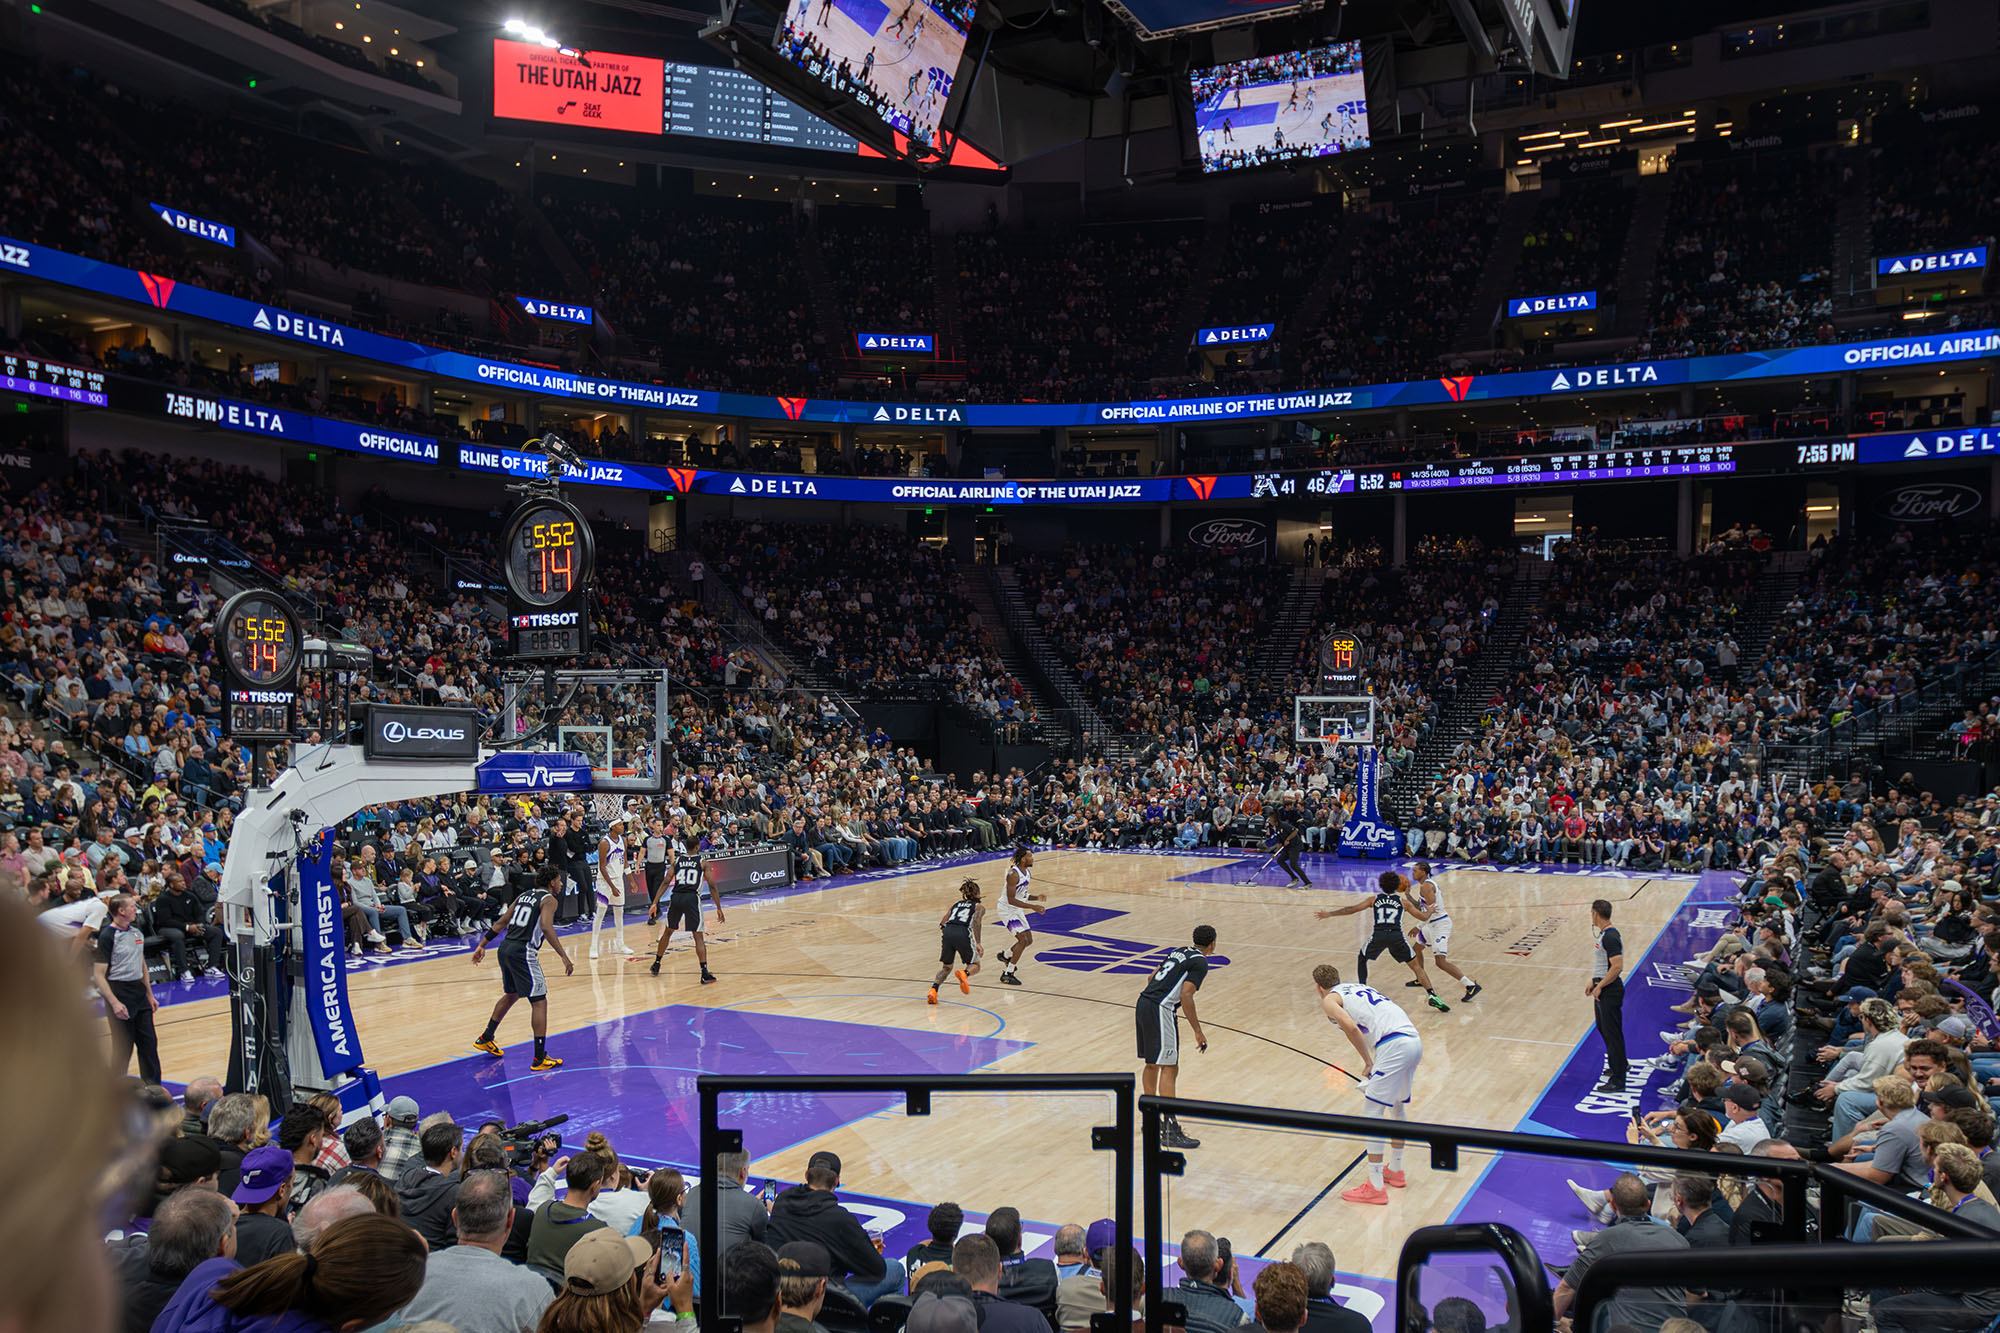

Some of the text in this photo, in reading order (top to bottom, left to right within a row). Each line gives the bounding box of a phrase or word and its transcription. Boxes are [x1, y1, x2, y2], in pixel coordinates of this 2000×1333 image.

[593, 61, 620, 70] PARTNER
[676, 65, 698, 75] SPURS
[517, 63, 642, 96] THE UTAH JAZZ
[583, 110, 602, 119] GEEK
[584, 102, 601, 111] SEAT
[175, 215, 229, 242] DELTA
[1910, 250, 1978, 272] DELTA
[538, 302, 586, 321] DELTA
[1534, 294, 1589, 313] DELTA
[275, 313, 345, 347] DELTA
[1221, 327, 1267, 341] DELTA
[880, 337, 927, 350] DELTA
[1844, 342, 1936, 364] OFFICIAL
[7, 365, 15, 376] 0
[28, 369, 37, 380] 11
[69, 376, 82, 388] 98
[89, 381, 102, 392] 114
[478, 363, 699, 407] OFFICIAL AIRLINE OF JAZZ
[1577, 365, 1659, 387] DELTA
[50, 385, 59, 396] 14
[69, 389, 82, 400] 116
[88, 392, 103, 403] 100
[166, 393, 217, 421] 7:55 PM
[895, 407, 961, 422] DELTA
[1101, 392, 1352, 420] OFFICIAL AIRLINE OF THE UTAH JAZZ
[359, 431, 438, 458] OFFICIAL AI
[1936, 433, 2000, 454] DEL
[1699, 454, 1710, 462] 98
[1718, 453, 1730, 461] 114
[1797, 442, 1855, 464] 7:55 PM
[459, 449, 499, 468] RLINE
[501, 455, 521, 470] OF
[591, 465, 623, 481] JAZZ
[1588, 470, 1597, 478] 15
[1360, 473, 1384, 490] 5:52
[1411, 471, 1430, 479] 14/35
[1411, 479, 1430, 487] 19/33
[751, 479, 817, 496] DELTA
[891, 484, 1141, 499] OFFICIAL AIRLINE OF THE UTAH JAZZ
[1280, 479, 1295, 494] 41
[1307, 477, 1325, 493] 46
[1388, 481, 1402, 489] 2ND
[1889, 489, 1962, 516] Ford
[533, 521, 575, 549] 5:52
[1202, 522, 1256, 544] Ford
[540, 548, 572, 594] 14
[530, 612, 579, 627] TISSOT
[246, 617, 285, 642] 5:52
[1333, 639, 1354, 651] 5:52
[252, 642, 277, 673] 14
[1335, 650, 1352, 668] 14
[249, 691, 294, 703] TISSOT
[407, 727, 465, 741] LEXUS
[1361, 763, 1370, 817] AMERICA FIRST
[676, 868, 698, 885] 40
[759, 870, 785, 880] LEXUS
[509, 904, 532, 927] 10
[948, 907, 970, 921] 14
[1376, 907, 1400, 924] 17
[317, 881, 350, 1056] AMERICA FIRST
[1155, 960, 1176, 981] 3
